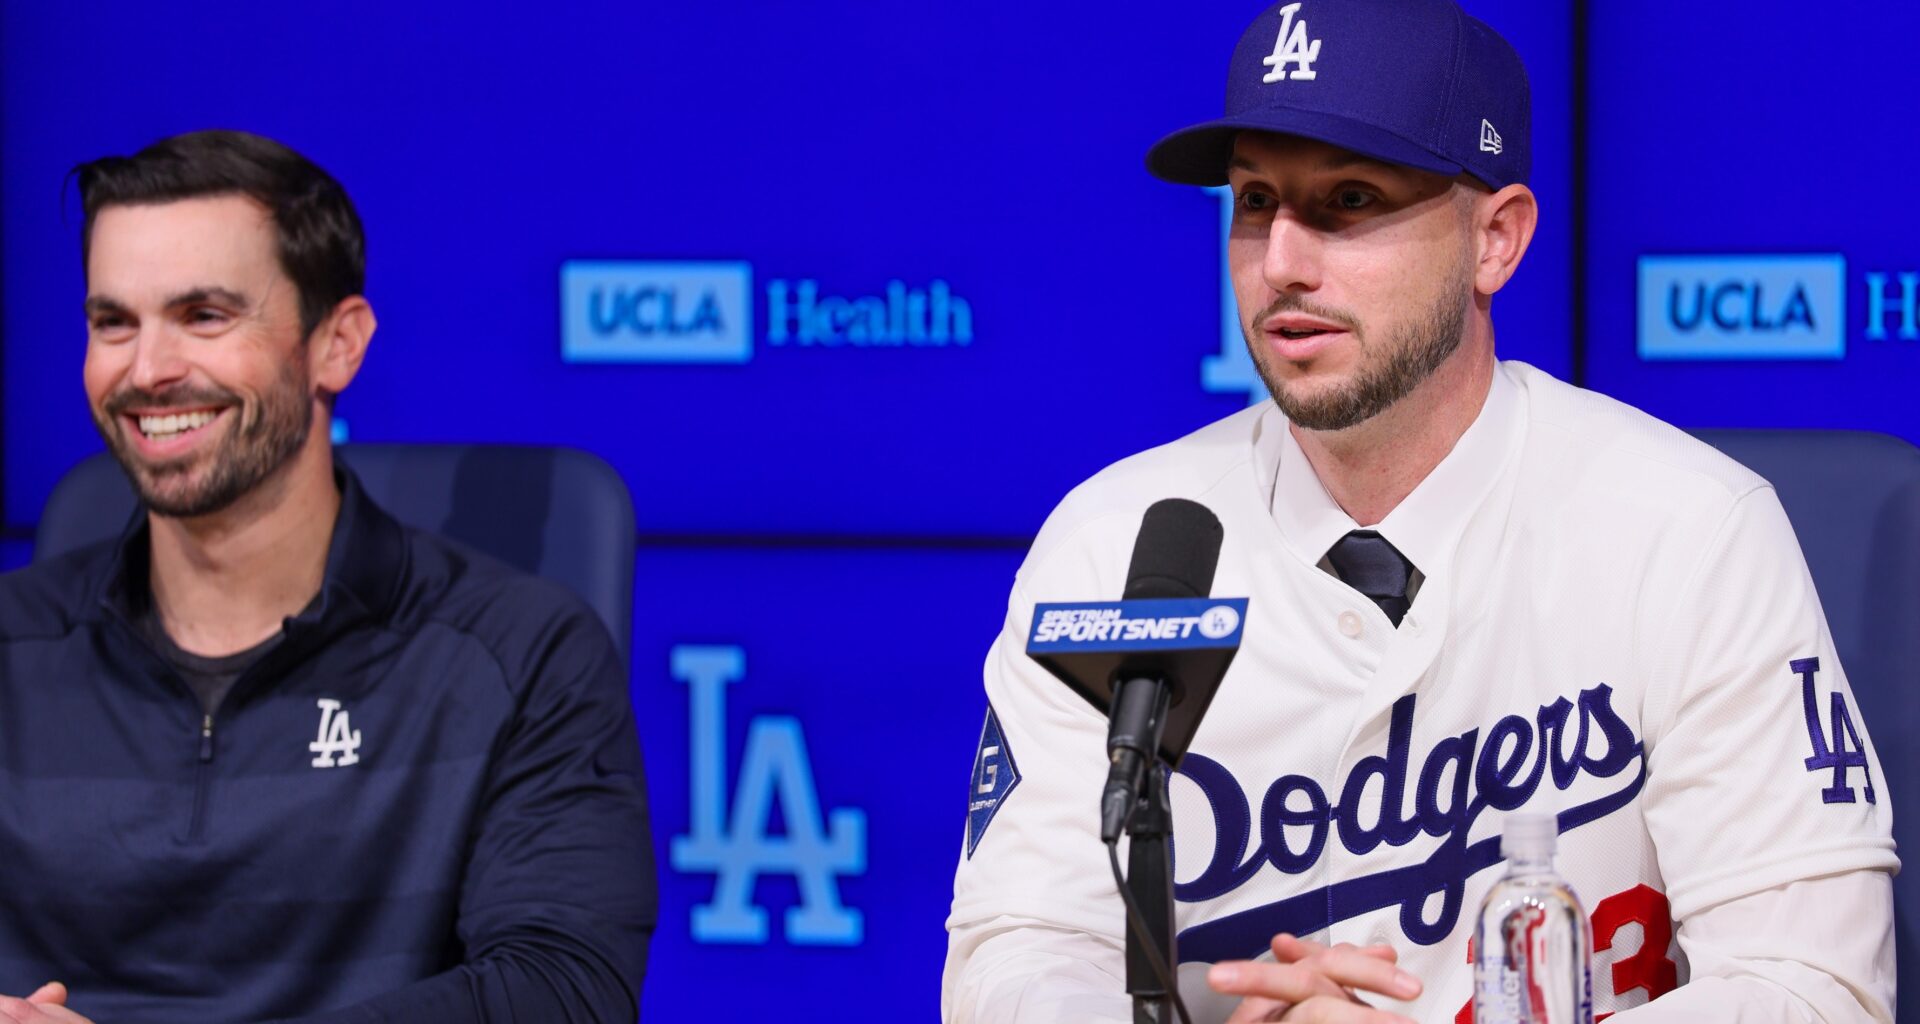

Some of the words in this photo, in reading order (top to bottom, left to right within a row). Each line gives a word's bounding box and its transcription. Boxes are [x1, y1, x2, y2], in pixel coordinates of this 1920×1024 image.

[1263, 2, 1322, 84] LA
[588, 285, 725, 338] UCLA
[766, 279, 974, 347] Health
[1666, 278, 1817, 335] UCLA
[1033, 617, 1202, 643] SPORTSNET
[1041, 609, 1122, 624] SPECTRUM
[309, 698, 362, 768] LA
[1789, 656, 1877, 806] LA
[669, 644, 868, 947] LA
[978, 745, 999, 794] G
[1167, 682, 1646, 946] Dodgers
